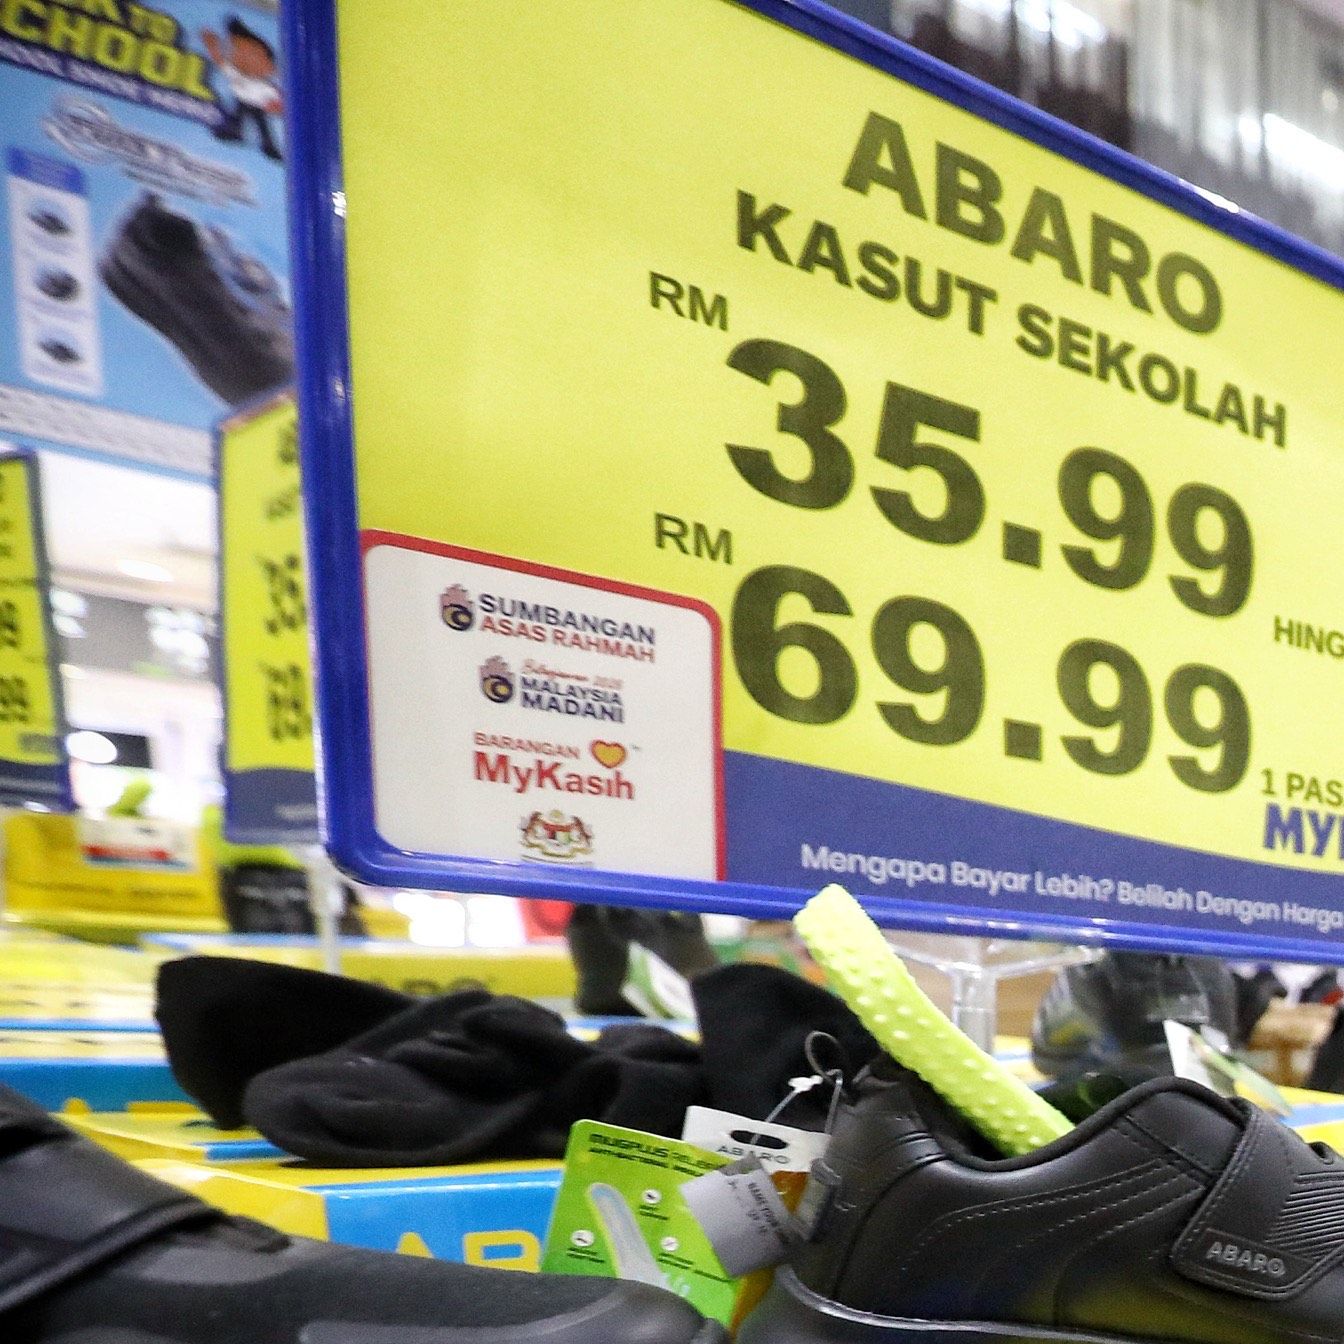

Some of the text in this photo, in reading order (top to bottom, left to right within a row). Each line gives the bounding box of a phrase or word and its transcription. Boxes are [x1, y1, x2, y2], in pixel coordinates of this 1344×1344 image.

[842, 111, 1223, 335] ABARO
[648, 272, 729, 332] RM
[735, 190, 1287, 448] KASUT SEKOLAH
[724, 337, 1255, 618] 35.99
[653, 513, 733, 565] RM
[478, 593, 656, 645] SUMBANGAN
[481, 616, 655, 663] ASAS RAHMAH
[520, 675, 623, 705] MALAYSIA
[730, 565, 1252, 793] 69.99
[521, 691, 625, 723] MADANI
[474, 732, 581, 759] BARANGAN
[473, 751, 636, 801] MyKasih
[1261, 768, 1277, 795] 1
[801, 843, 946, 885] Mengapa
[950, 861, 1030, 896] Bayar
[1035, 870, 1116, 902] Lebih?
[1117, 881, 1193, 912] Belilah
[1194, 891, 1281, 925] Dengan
[1282, 900, 1344, 933] Harga
[1205, 1240, 1286, 1276] ABARO
